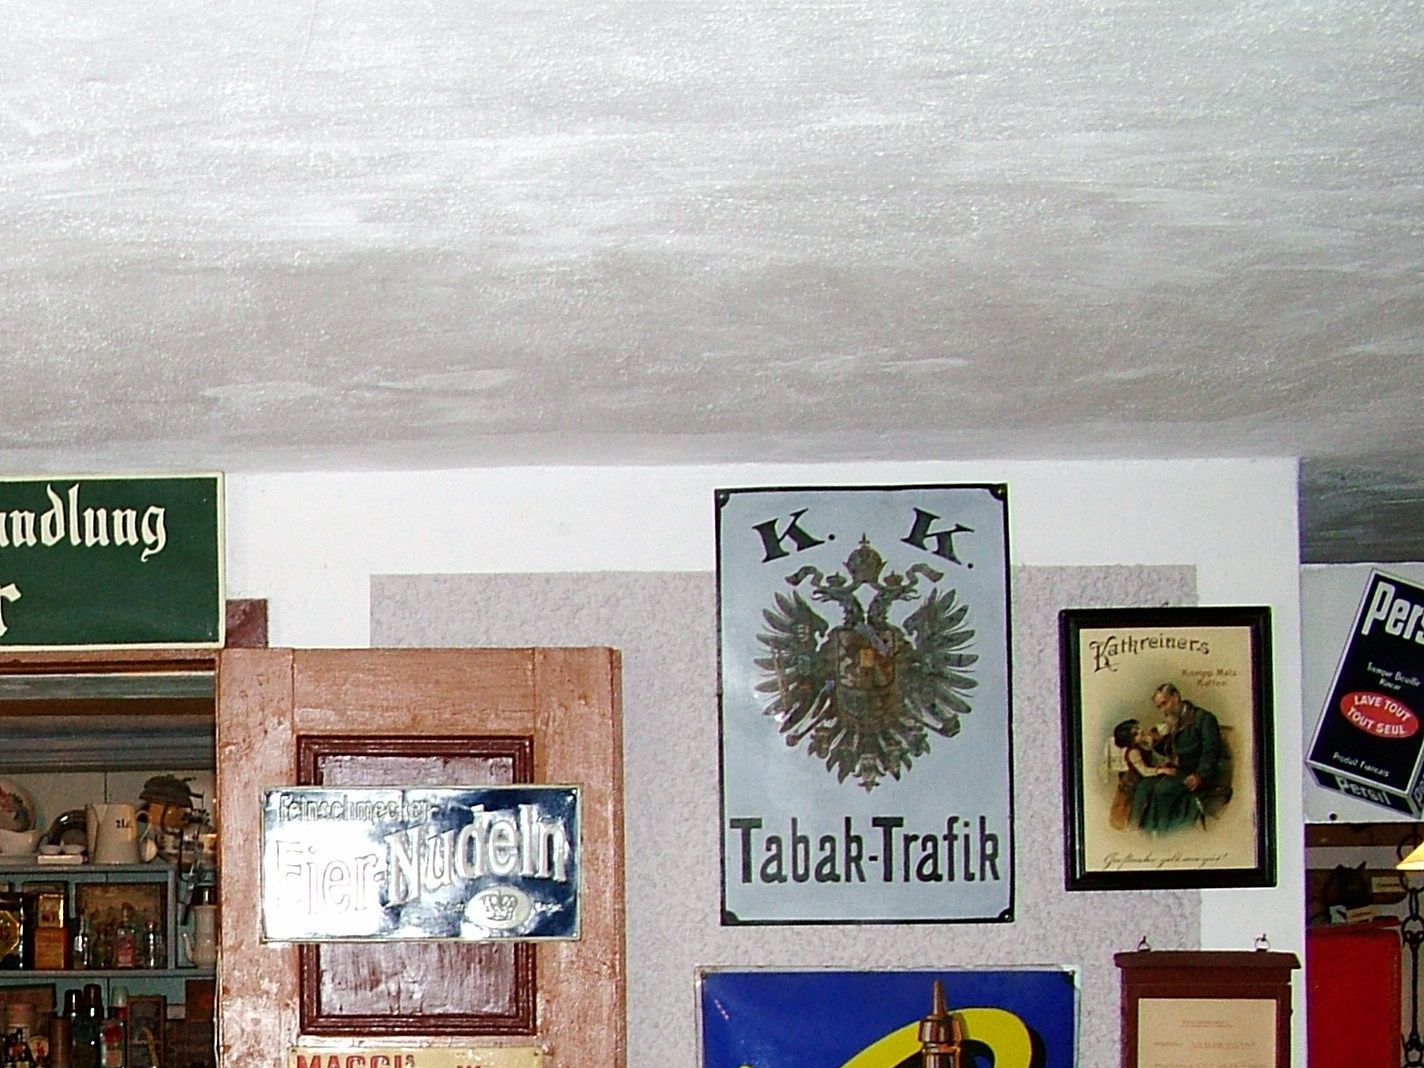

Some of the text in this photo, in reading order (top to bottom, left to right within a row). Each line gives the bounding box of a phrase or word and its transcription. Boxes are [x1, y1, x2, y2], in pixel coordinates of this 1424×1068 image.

[752, 507, 975, 569] K. K.
[1347, 707, 1406, 735] TOUT SEUL
[1354, 694, 1411, 721] LAVE TOUT
[730, 816, 1000, 884] Tabak-Trafik
